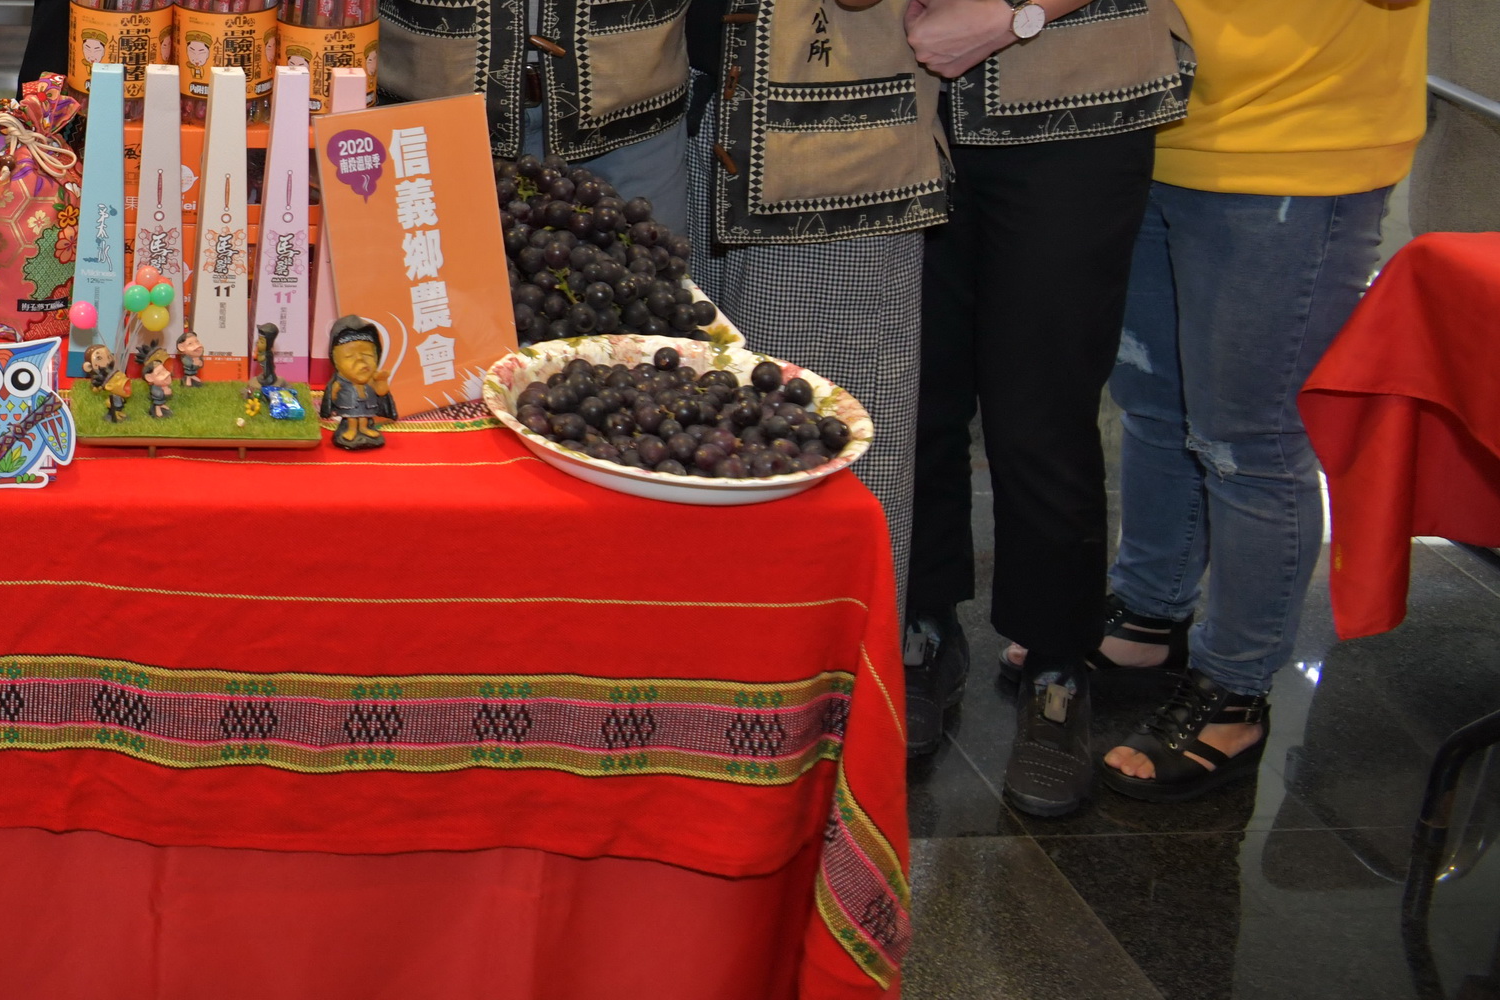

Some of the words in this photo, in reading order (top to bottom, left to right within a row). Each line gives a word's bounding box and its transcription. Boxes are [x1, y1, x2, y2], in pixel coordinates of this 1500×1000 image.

[338, 137, 374, 156] 2020
[389, 126, 456, 386] 信義鄉農會
